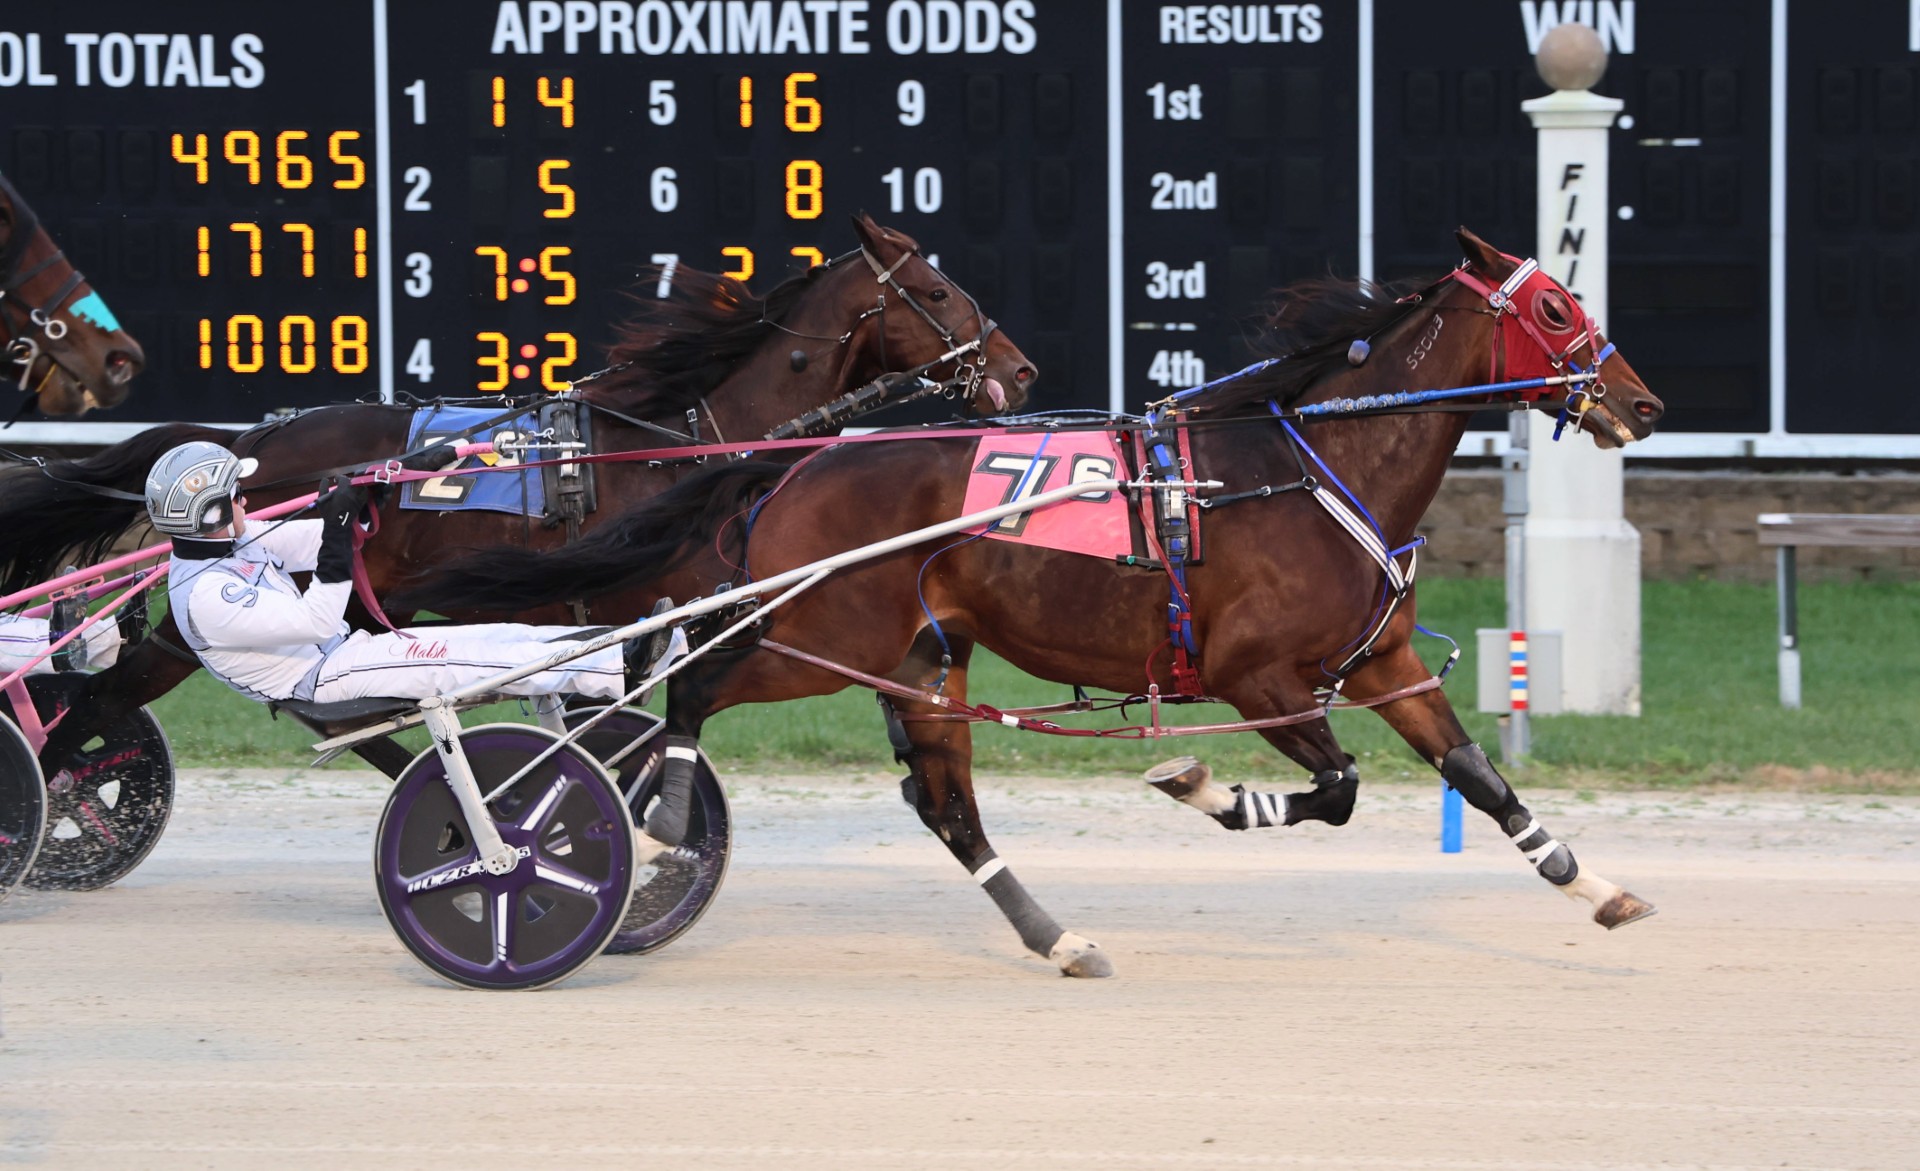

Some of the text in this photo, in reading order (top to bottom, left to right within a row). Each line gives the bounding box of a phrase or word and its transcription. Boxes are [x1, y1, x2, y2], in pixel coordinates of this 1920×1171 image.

[491, 0, 1037, 55] APPROXIMATE ODDS
[1160, 4, 1323, 44] RESULTS
[65, 33, 265, 88] TOTALS
[405, 80, 426, 125] 1
[649, 80, 677, 126] 5
[898, 80, 925, 126] 9
[1147, 83, 1203, 120] 1st
[171, 130, 366, 189] 4965
[404, 167, 431, 211] 2
[538, 159, 576, 219] 5
[651, 167, 678, 213] 6
[785, 159, 823, 219] 8
[882, 167, 943, 213] 10
[1151, 172, 1218, 210] 2nd
[198, 222, 368, 278] 1771
[1557, 163, 1584, 301] FINI
[405, 252, 432, 297] 3
[651, 253, 679, 298] 7
[1146, 261, 1205, 299] 3rd
[199, 314, 369, 374] 1008
[405, 339, 434, 382] 4
[1147, 349, 1206, 387] 4th
[414, 434, 474, 502] 2
[981, 454, 1056, 533] 7
